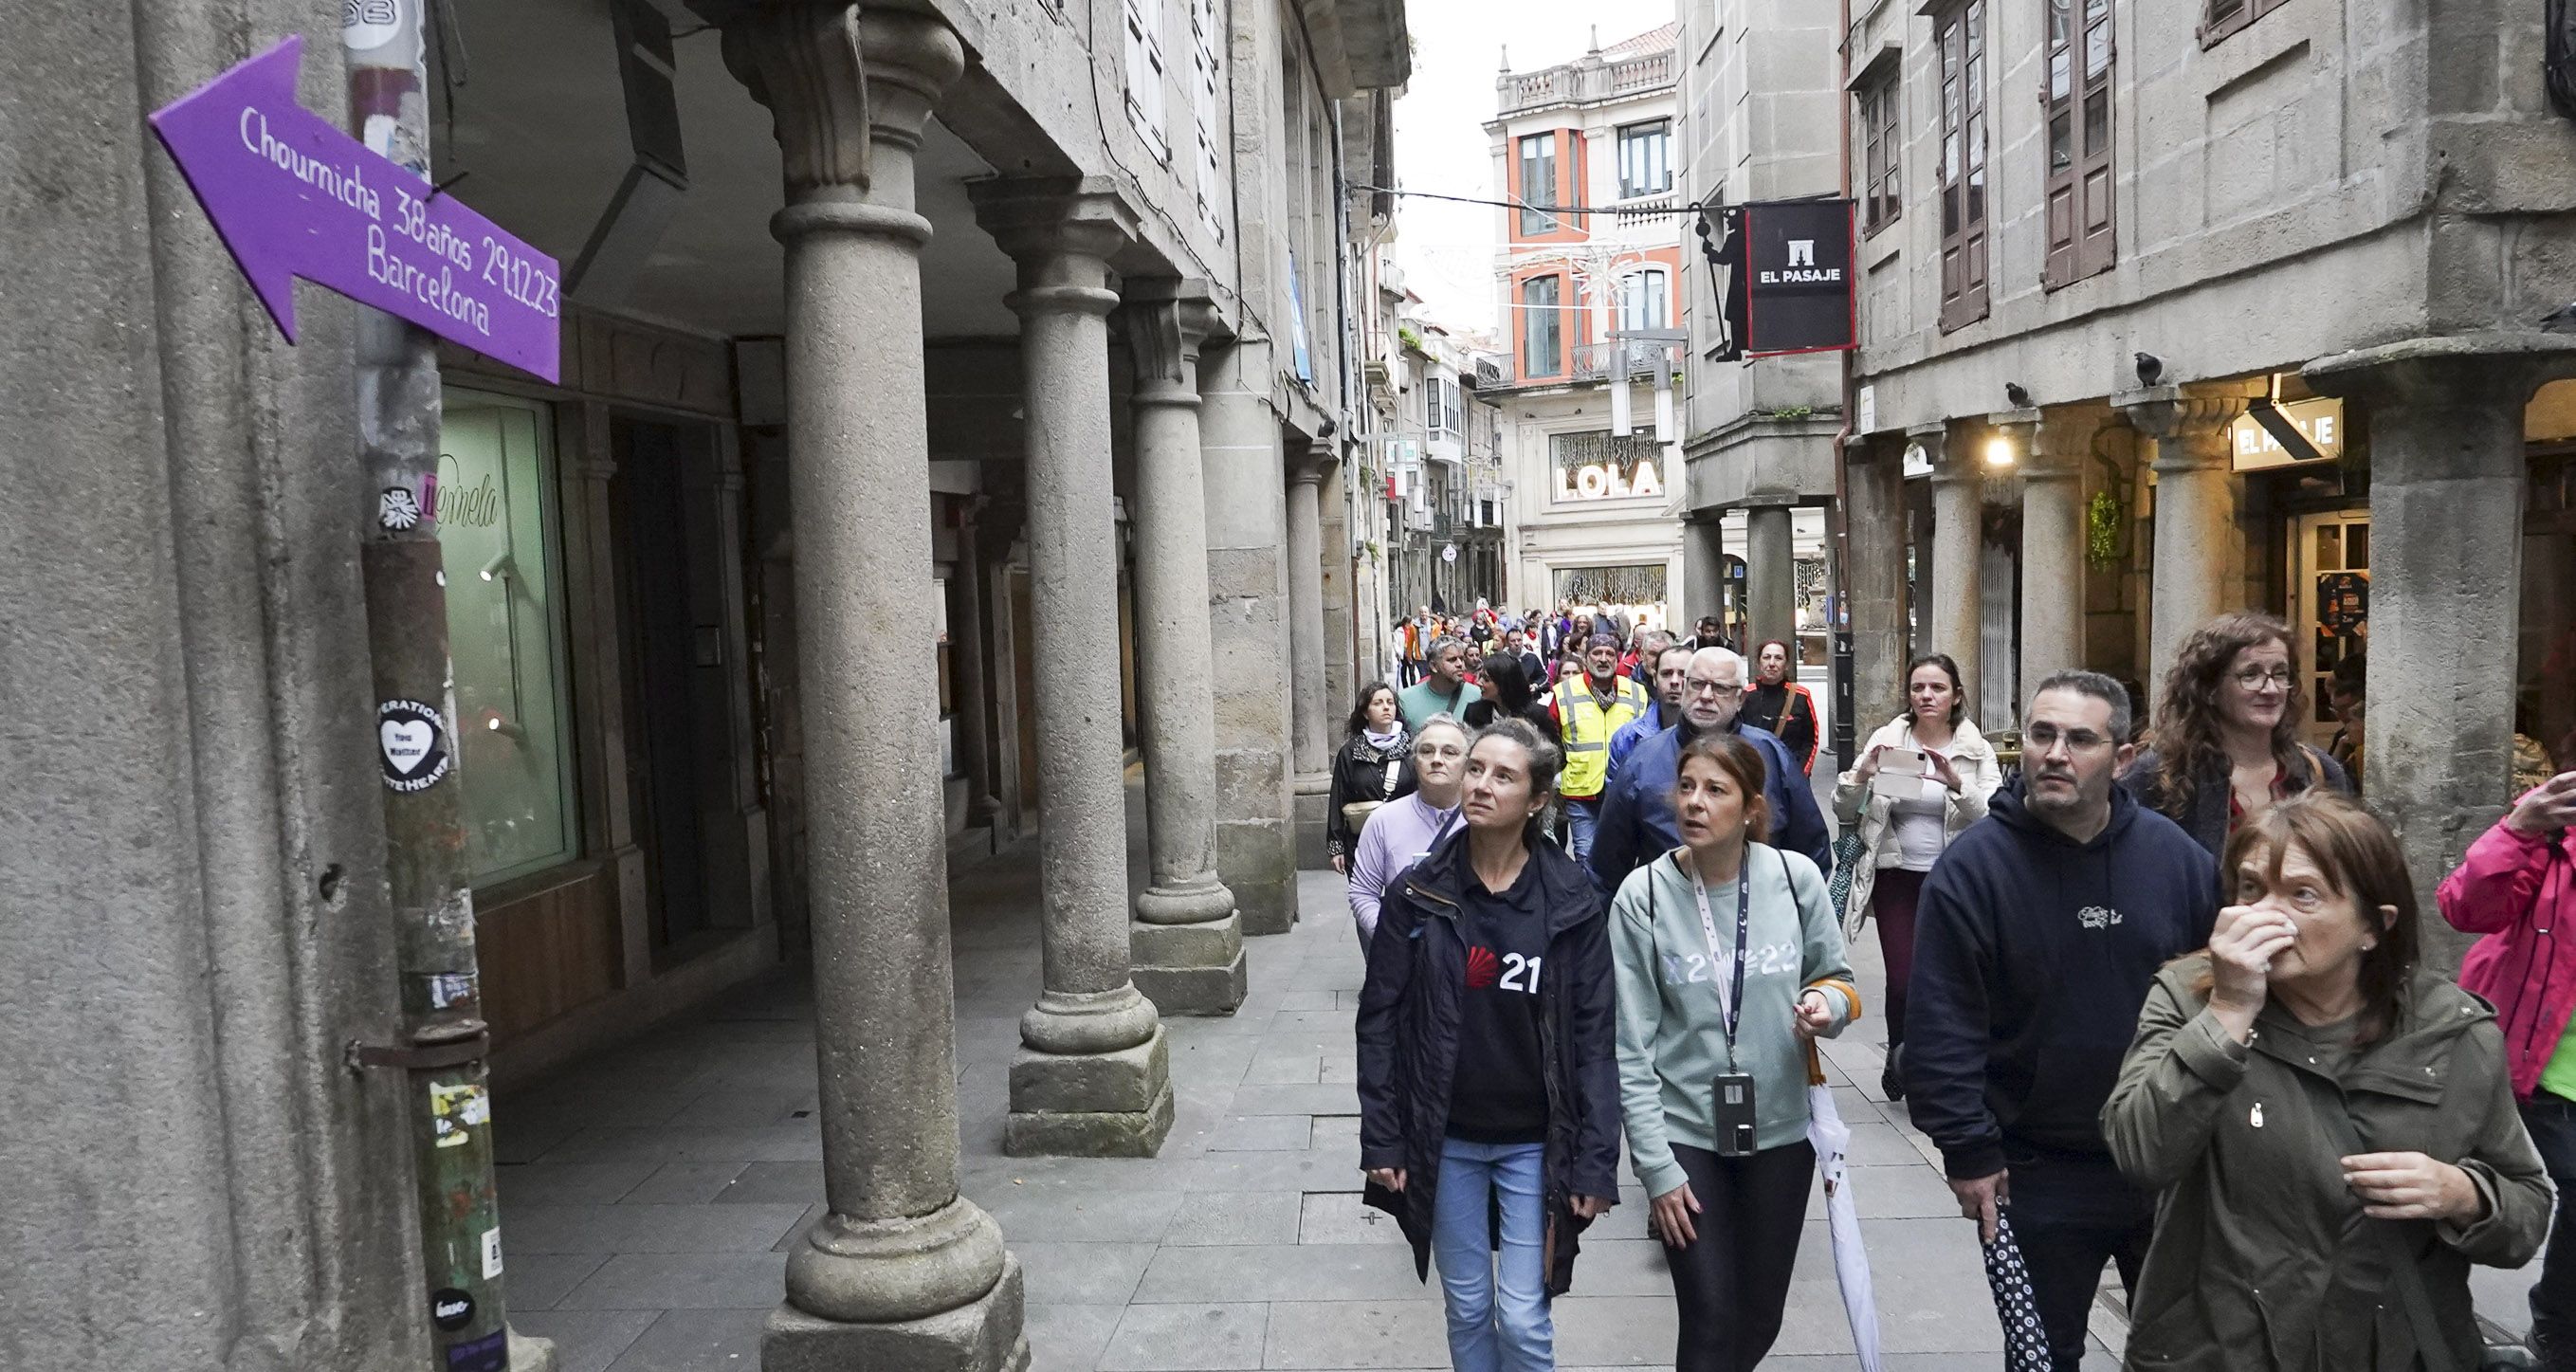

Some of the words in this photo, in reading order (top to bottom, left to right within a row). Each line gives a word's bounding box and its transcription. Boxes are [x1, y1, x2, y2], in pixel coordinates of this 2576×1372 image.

[240, 105, 382, 222] Choumicha
[367, 224, 490, 337] Barcelona
[1760, 270, 1780, 284] EL
[1781, 267, 1841, 284] PASAJE
[2238, 429, 2260, 455] EL
[435, 453, 498, 535] emela
[1556, 461, 1662, 501] LOLA
[1499, 951, 1543, 995] 21
